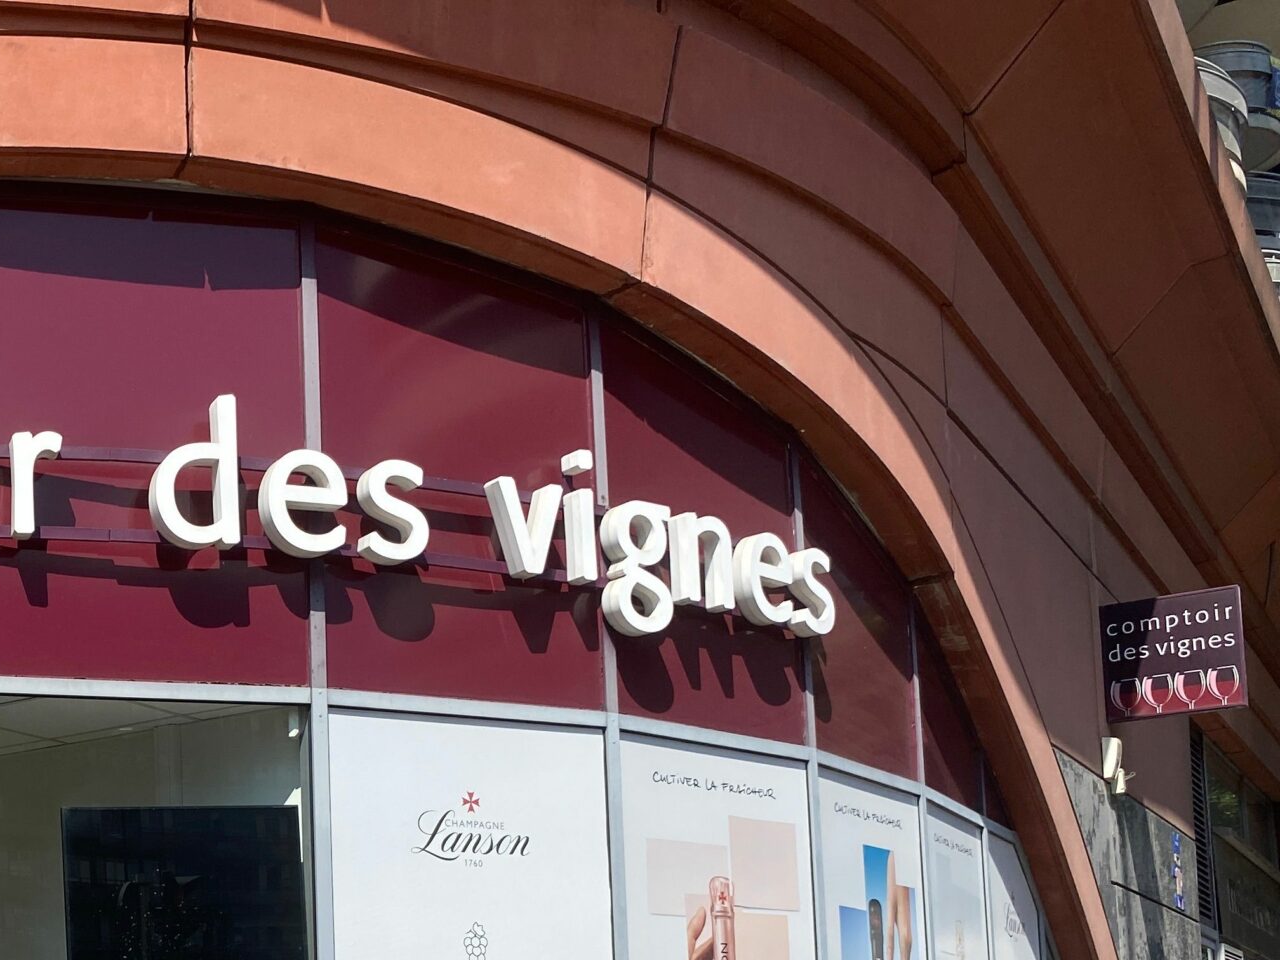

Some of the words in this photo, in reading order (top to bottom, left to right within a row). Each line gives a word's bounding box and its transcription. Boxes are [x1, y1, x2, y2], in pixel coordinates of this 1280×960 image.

[148, 394, 429, 565] des
[484, 449, 835, 638] vignes
[1107, 604, 1232, 636] comptoir
[1109, 644, 1149, 662] des
[1156, 633, 1235, 658] vignes
[652, 771, 701, 788] CULTIVER
[705, 778, 718, 791] LA
[411, 810, 530, 861] Lanson
[445, 819, 505, 830] CHAMPAGNE
[465, 859, 483, 867] 1760
